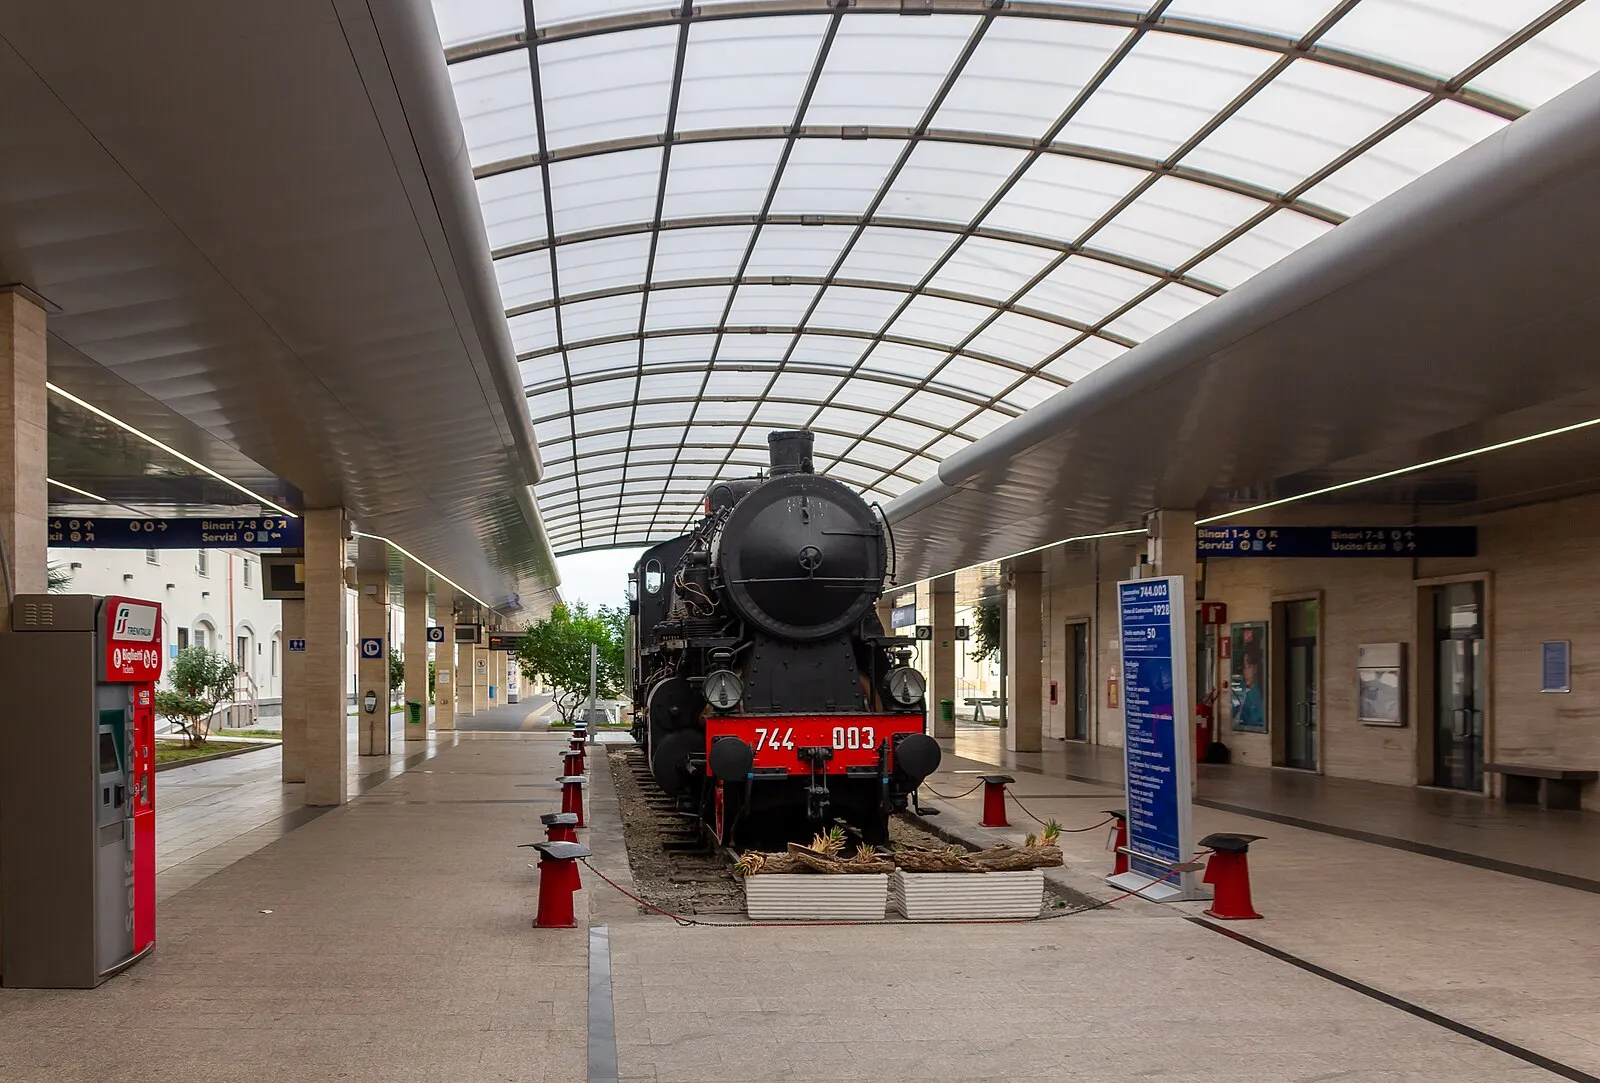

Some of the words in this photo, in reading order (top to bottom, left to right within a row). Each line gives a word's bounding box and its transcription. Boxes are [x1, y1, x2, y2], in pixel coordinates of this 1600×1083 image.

[48, 520, 62, 529] -6
[201, 520, 235, 530] Binari
[237, 520, 257, 530] 7-8
[201, 532, 238, 542] Servizi
[1198, 529, 1229, 538] Binari
[1232, 529, 1251, 539] 1-6
[1198, 540, 1234, 550] Servizi
[1139, 584, 1167, 598] 744.003
[1153, 604, 1170, 616] 1928
[1146, 627, 1156, 639] 50
[755, 726, 795, 751] 744
[832, 726, 875, 750] 003
